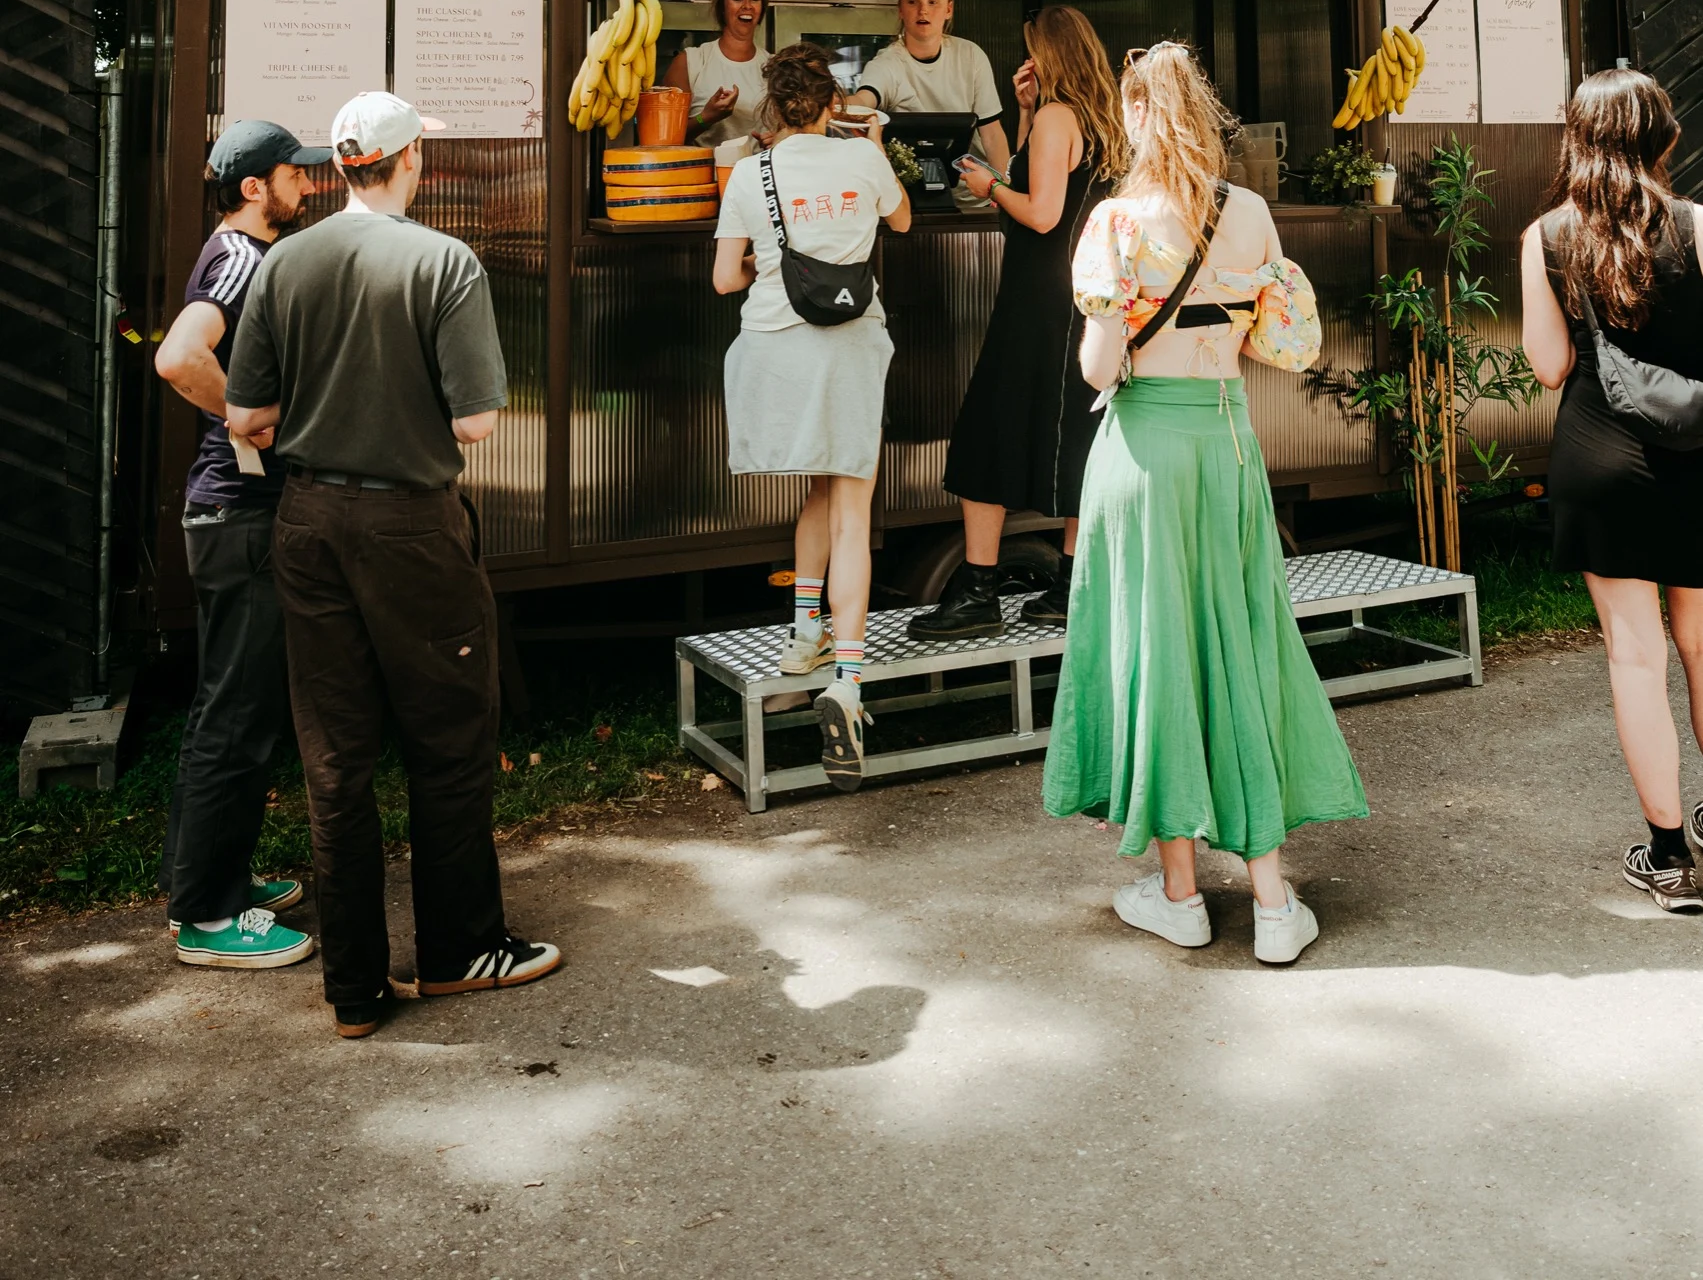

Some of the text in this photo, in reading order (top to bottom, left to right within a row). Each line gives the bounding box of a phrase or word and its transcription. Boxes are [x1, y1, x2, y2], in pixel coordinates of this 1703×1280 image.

[417, 7, 433, 15] THE
[263, 22, 299, 30] VITAMIN
[301, 22, 342, 30] BOOSTER
[416, 30, 440, 38] SPICY
[416, 53, 450, 61] GLUTEN
[268, 64, 298, 72] TRIPLE
[416, 76, 453, 84] CROQUE
[415, 99, 453, 108] CROQUE
[761, 164, 774, 191] ALDI
[767, 194, 780, 221] ALDI
[1653, 870, 1683, 881] SALOMON
[1259, 914, 1283, 922] Reebok
